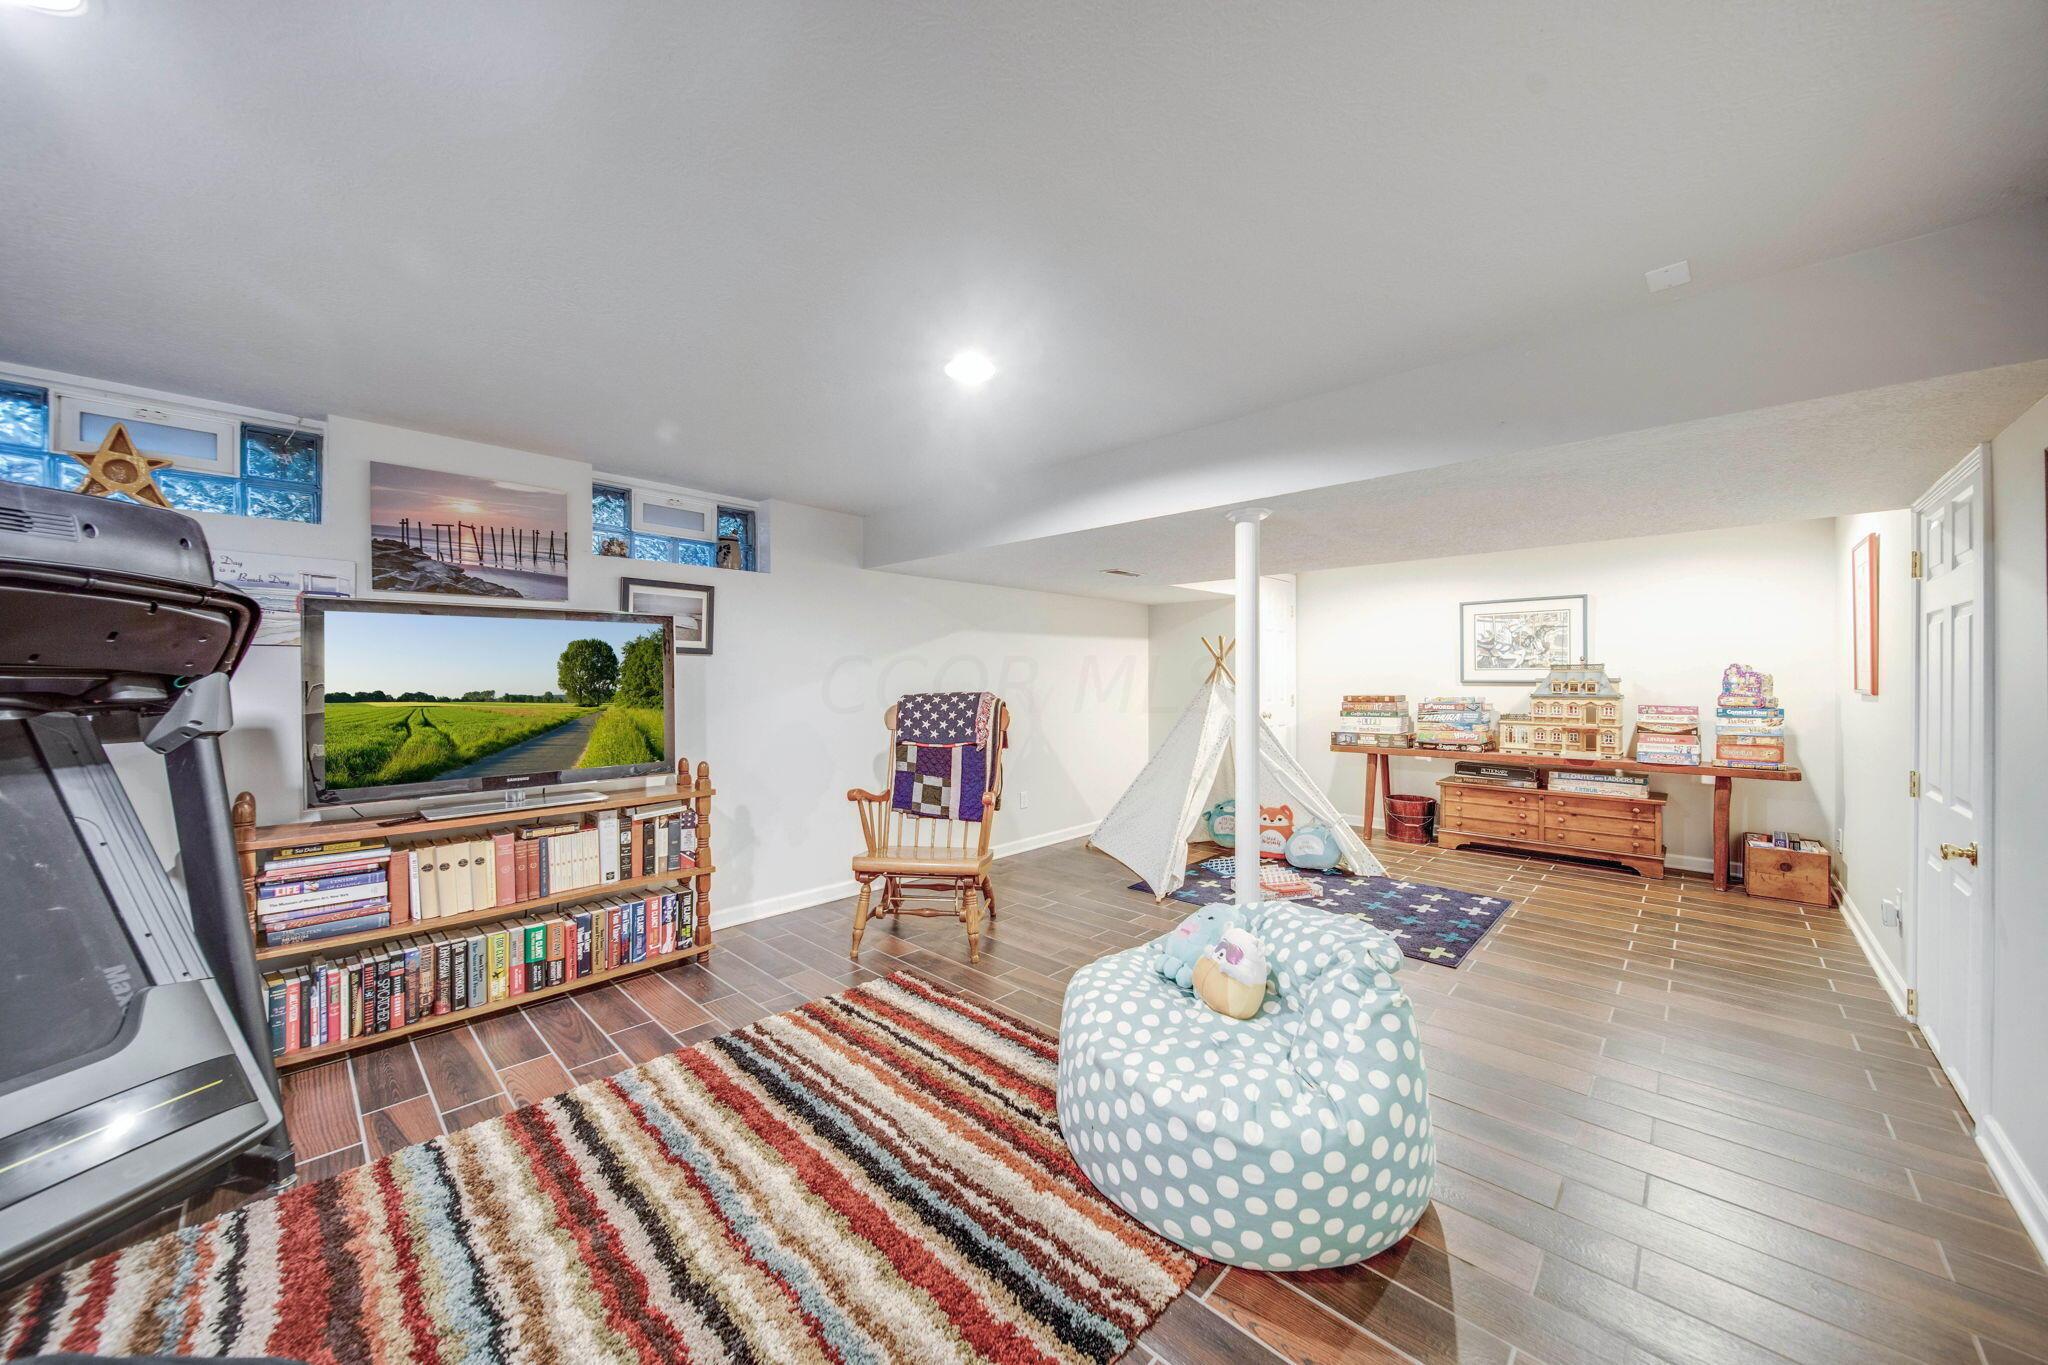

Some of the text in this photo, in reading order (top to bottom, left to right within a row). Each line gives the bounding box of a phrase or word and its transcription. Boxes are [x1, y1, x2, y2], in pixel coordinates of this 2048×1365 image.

[220, 555, 243, 567] Day
[237, 572, 290, 586] Beach Day
[1422, 713, 1461, 721] ZATHURA
[1569, 773, 1594, 781] CHUTES
[1604, 776, 1634, 784] LADDERS
[274, 883, 301, 897] LIFE
[636, 904, 644, 915] TOM
[636, 915, 644, 934] CLANCY
[611, 923, 620, 943] Clancy
[439, 944, 450, 958] JOHN
[103, 964, 132, 1014] Max
[377, 978, 389, 1023] SPYCATCHER
